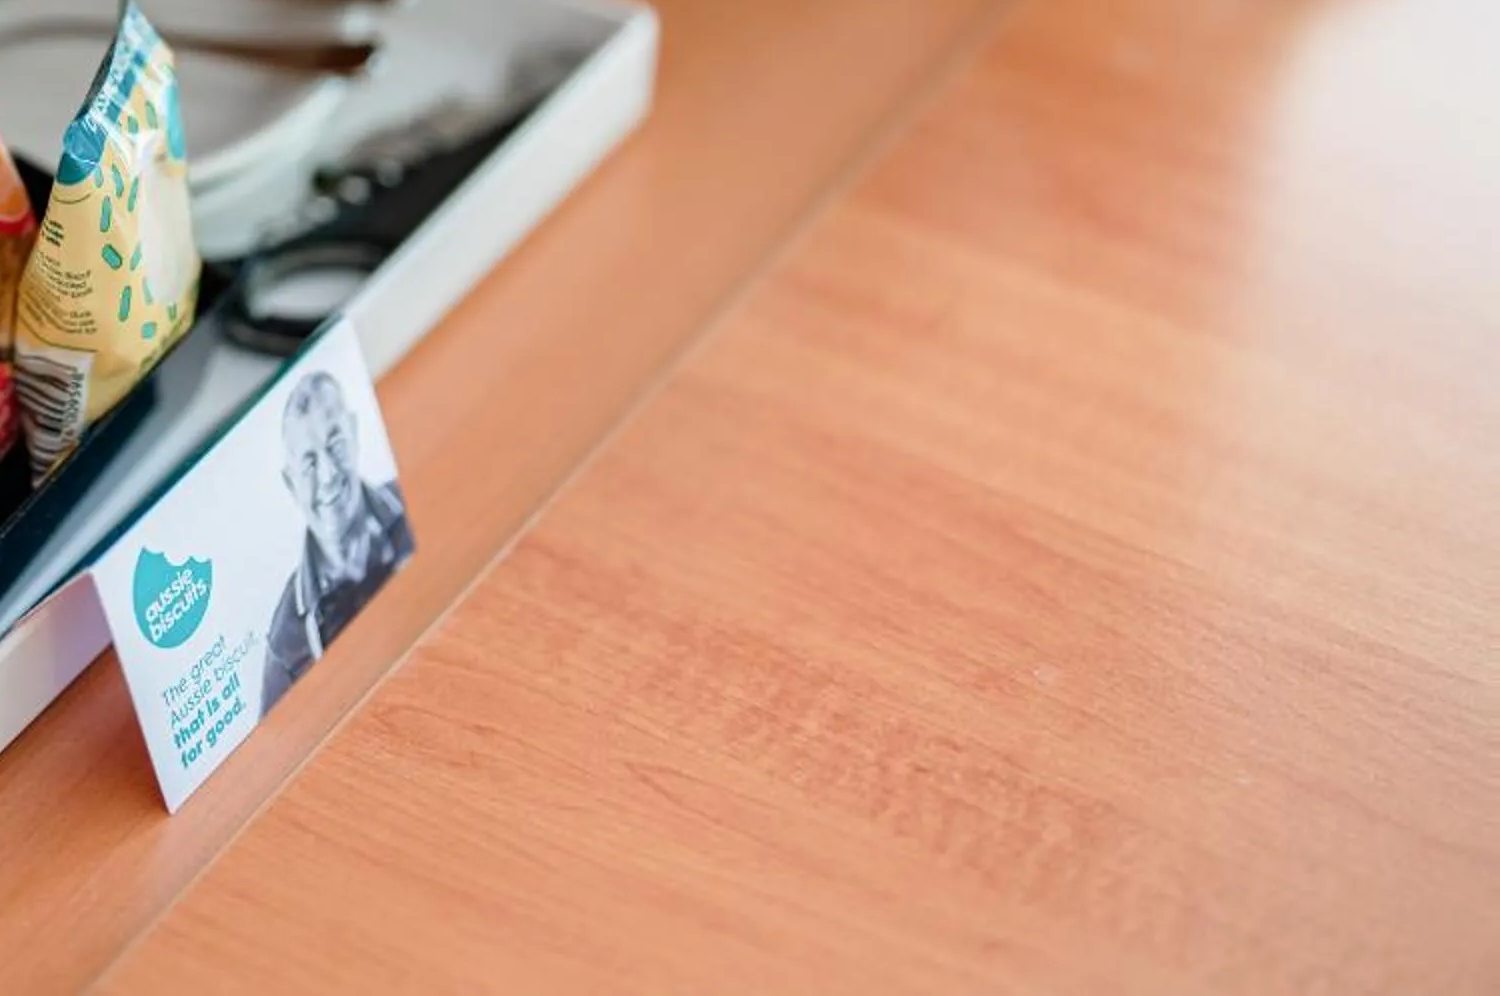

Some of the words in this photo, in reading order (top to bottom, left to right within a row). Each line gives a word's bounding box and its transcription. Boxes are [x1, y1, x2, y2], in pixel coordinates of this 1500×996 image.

[145, 569, 193, 621] aussie
[149, 580, 207, 642] biscuits
[163, 677, 188, 705] The
[190, 635, 226, 684] great
[171, 677, 212, 727] Aussie
[174, 710, 206, 748] that
[206, 698, 220, 717] is
[221, 672, 241, 699] all
[180, 741, 203, 768] for
[206, 697, 247, 747] good.
